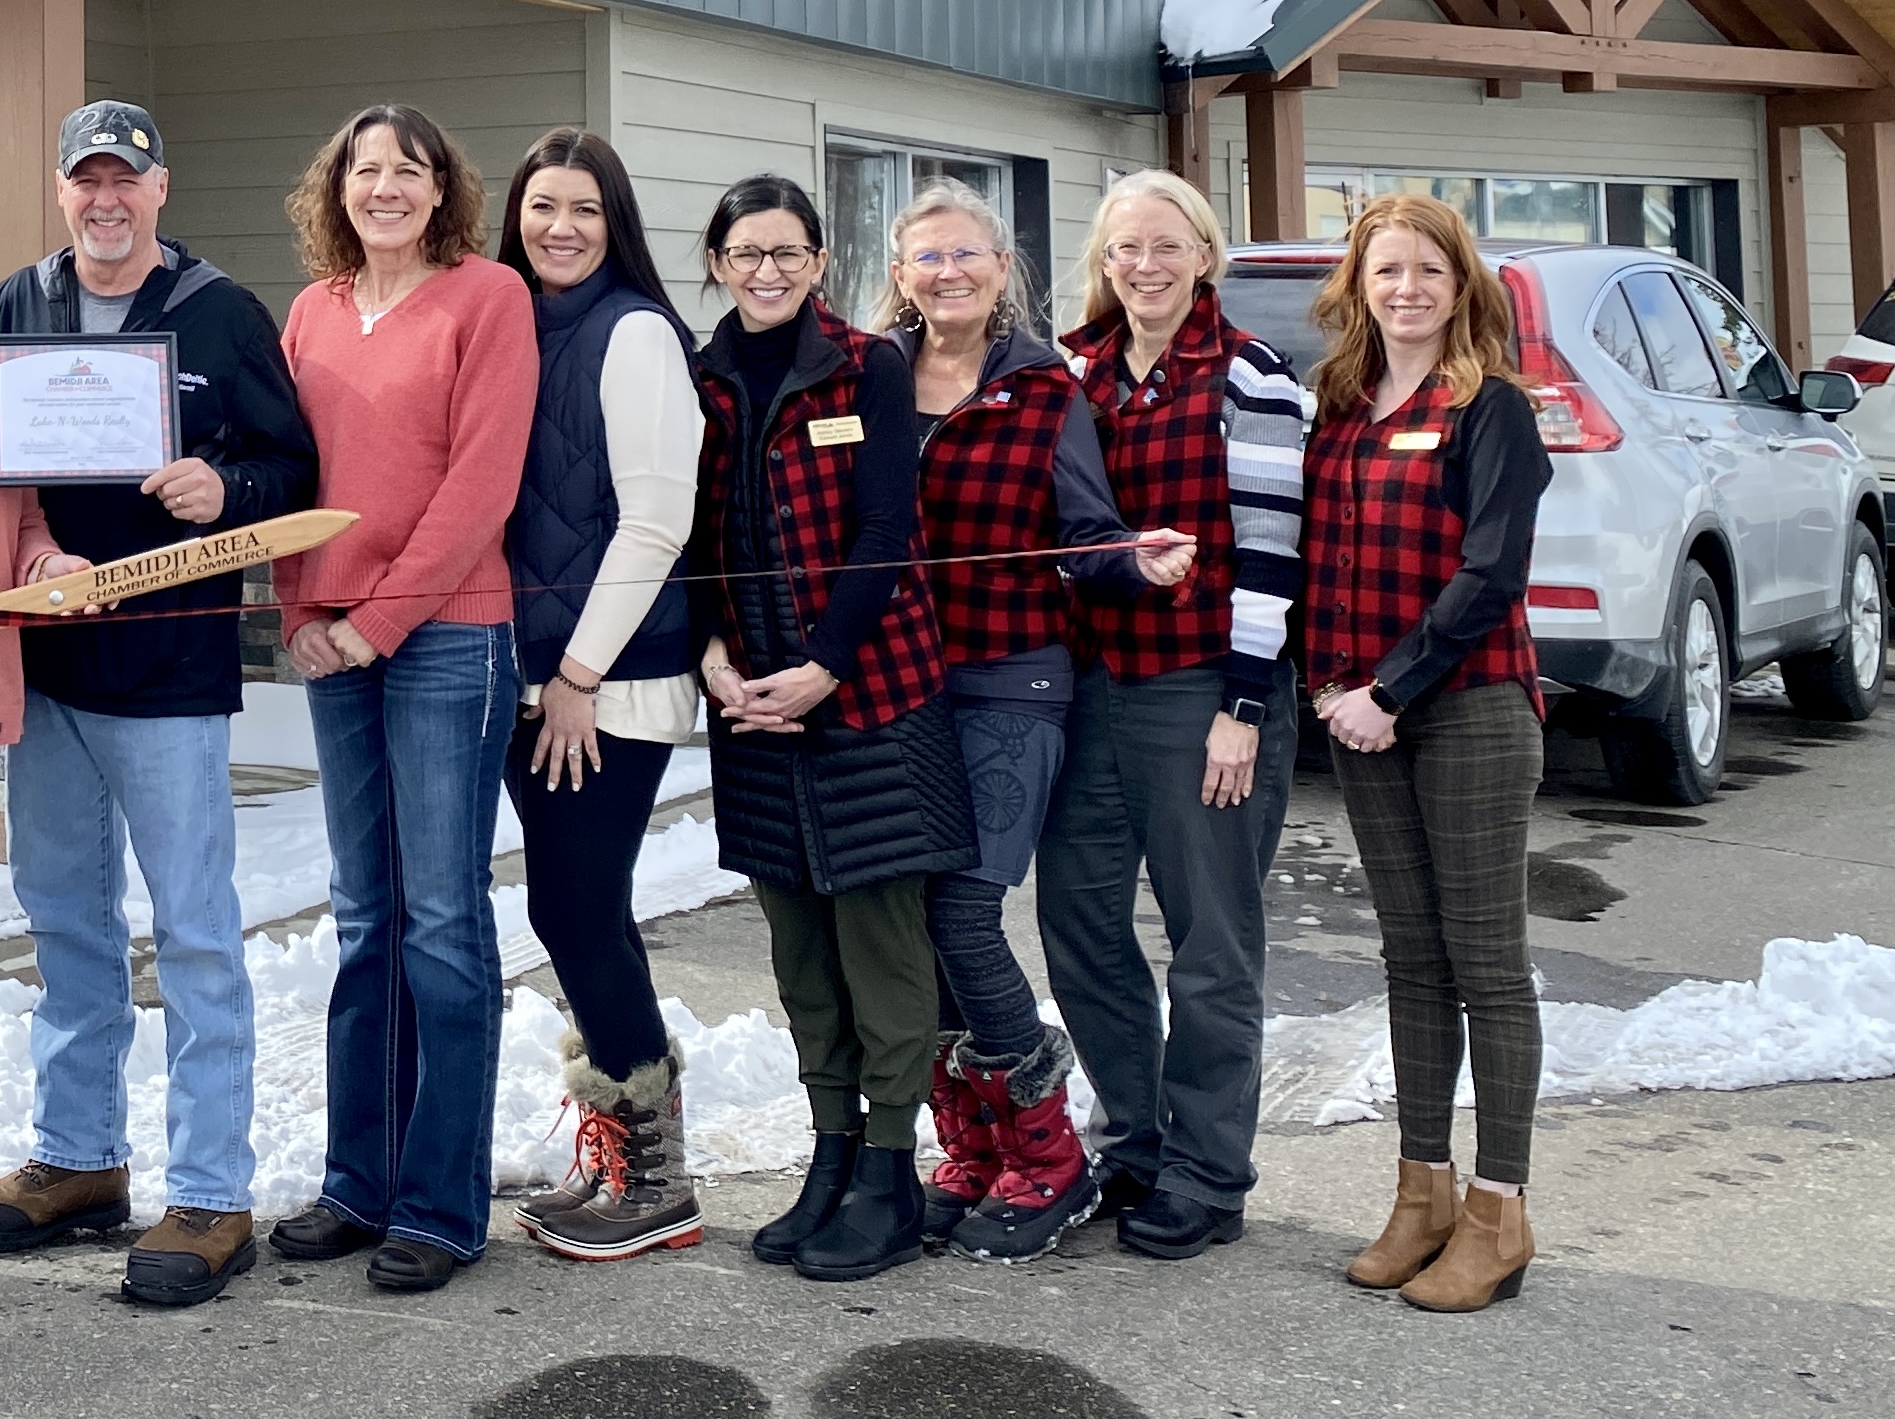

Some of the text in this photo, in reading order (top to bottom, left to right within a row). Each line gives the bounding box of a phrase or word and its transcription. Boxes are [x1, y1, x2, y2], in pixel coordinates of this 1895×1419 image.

[48, 376, 110, 386] BEMIDJI AREA
[86, 546, 276, 602] CHAMBER OF COMMERCE
[93, 531, 261, 588] BEMIDJI AREA
